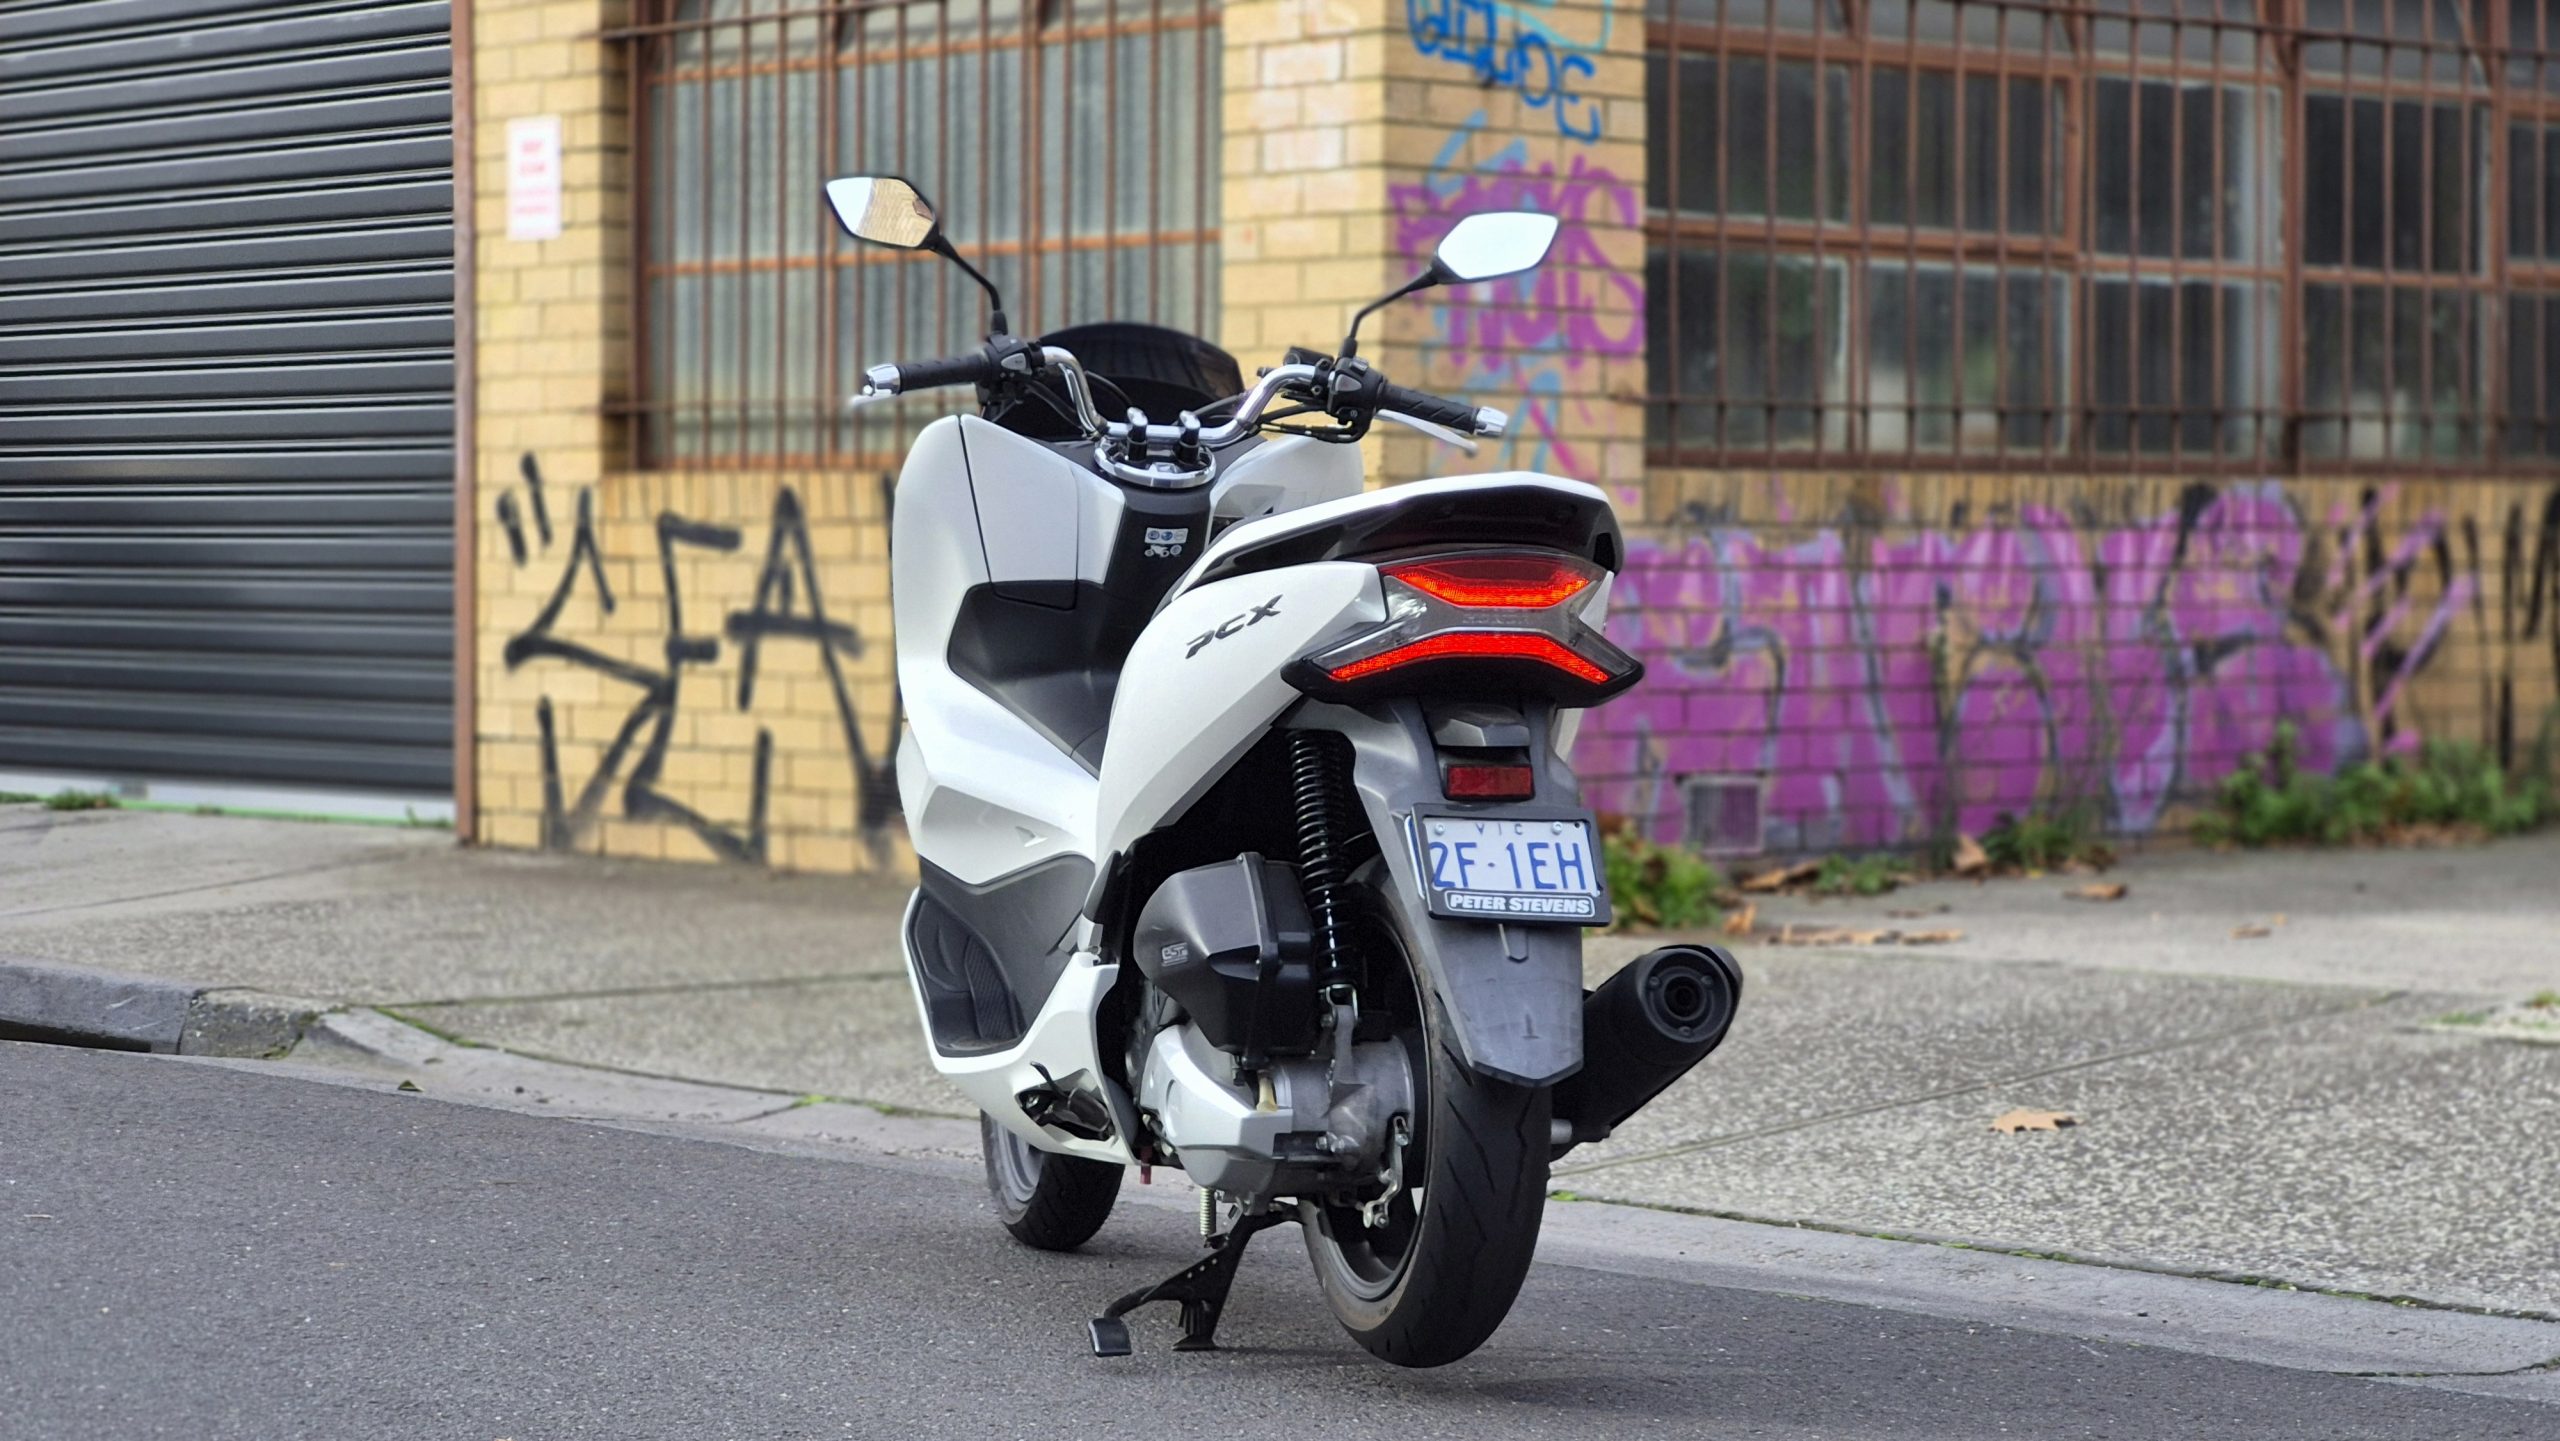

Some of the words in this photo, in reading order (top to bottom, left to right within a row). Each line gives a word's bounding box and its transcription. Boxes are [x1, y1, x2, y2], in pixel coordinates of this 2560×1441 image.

[1185, 594, 1284, 659] PCX
[1476, 823, 1523, 836] VIC
[1450, 894, 1507, 911] PETER
[1509, 897, 1590, 914] STEVENS
